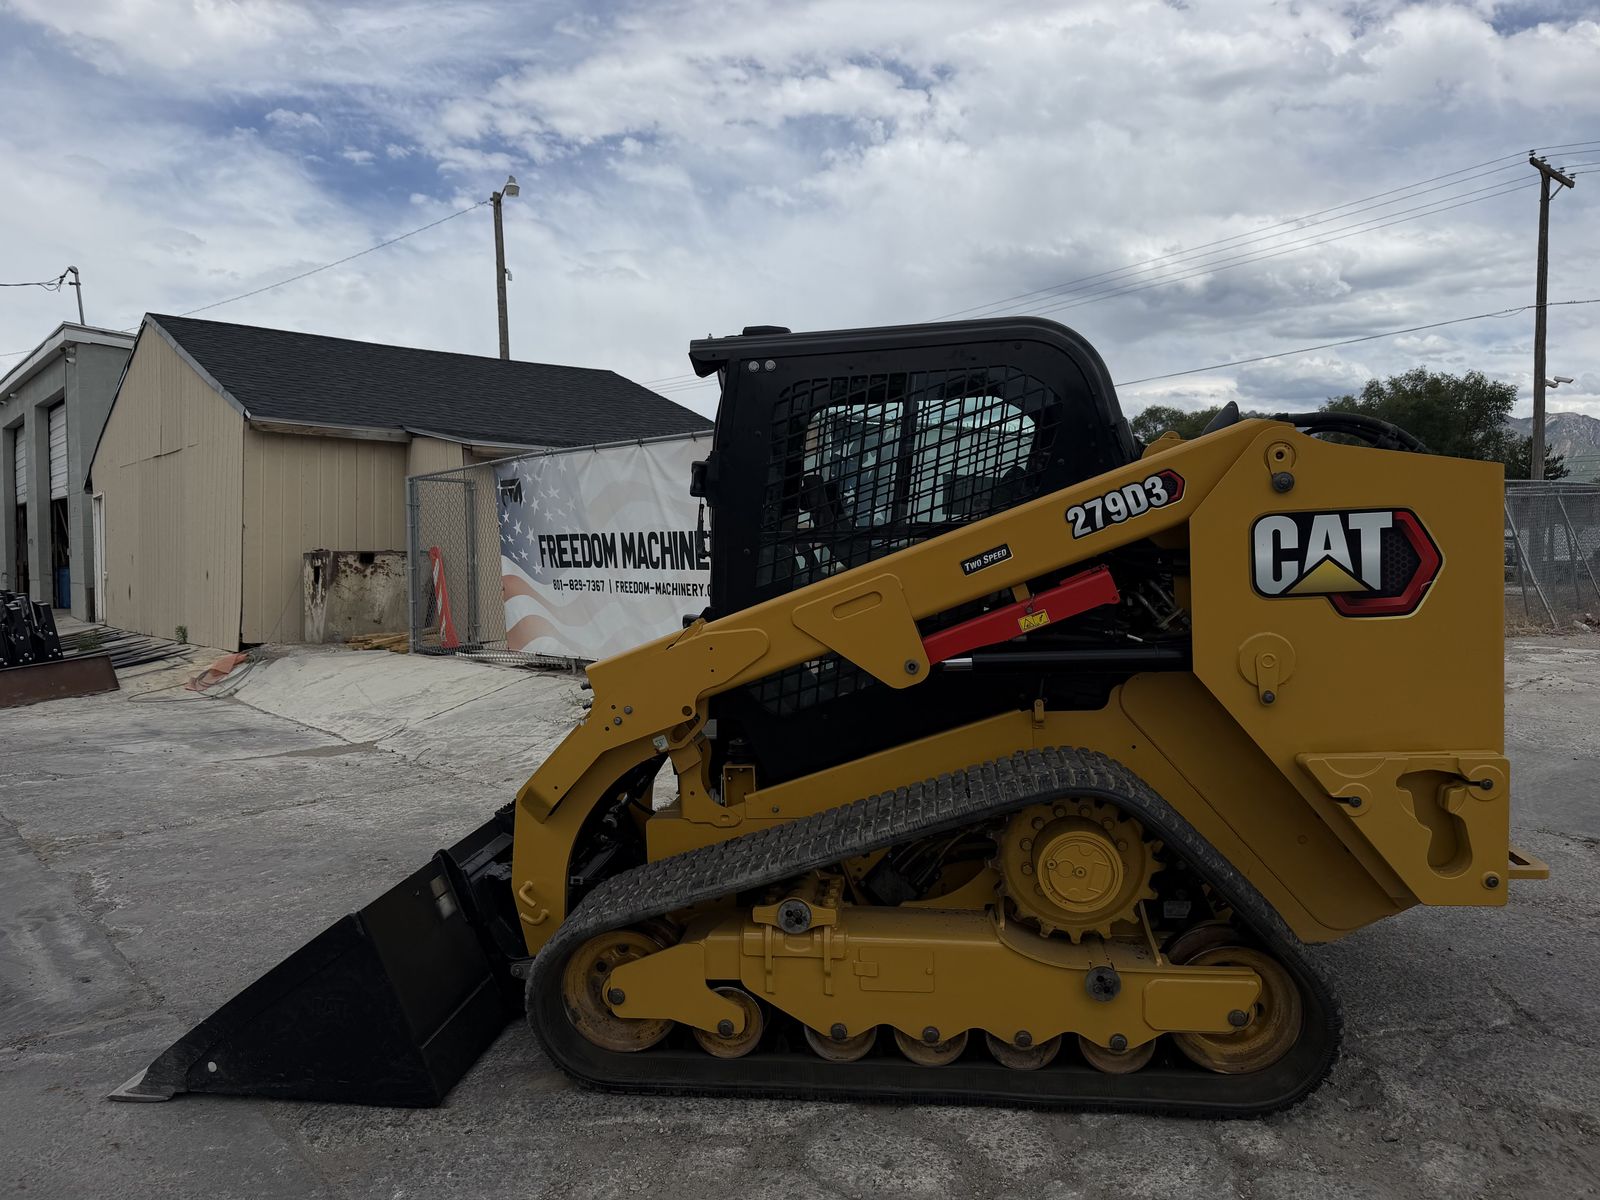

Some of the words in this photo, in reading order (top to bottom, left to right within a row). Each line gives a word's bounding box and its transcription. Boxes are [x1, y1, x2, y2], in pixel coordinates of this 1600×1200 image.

[1066, 475, 1168, 538] 279D3
[538, 532, 618, 569] FREEDOM
[983, 548, 1007, 564] SPEED
[1254, 511, 1392, 595] CAT
[552, 579, 605, 592] 801-829-7367
